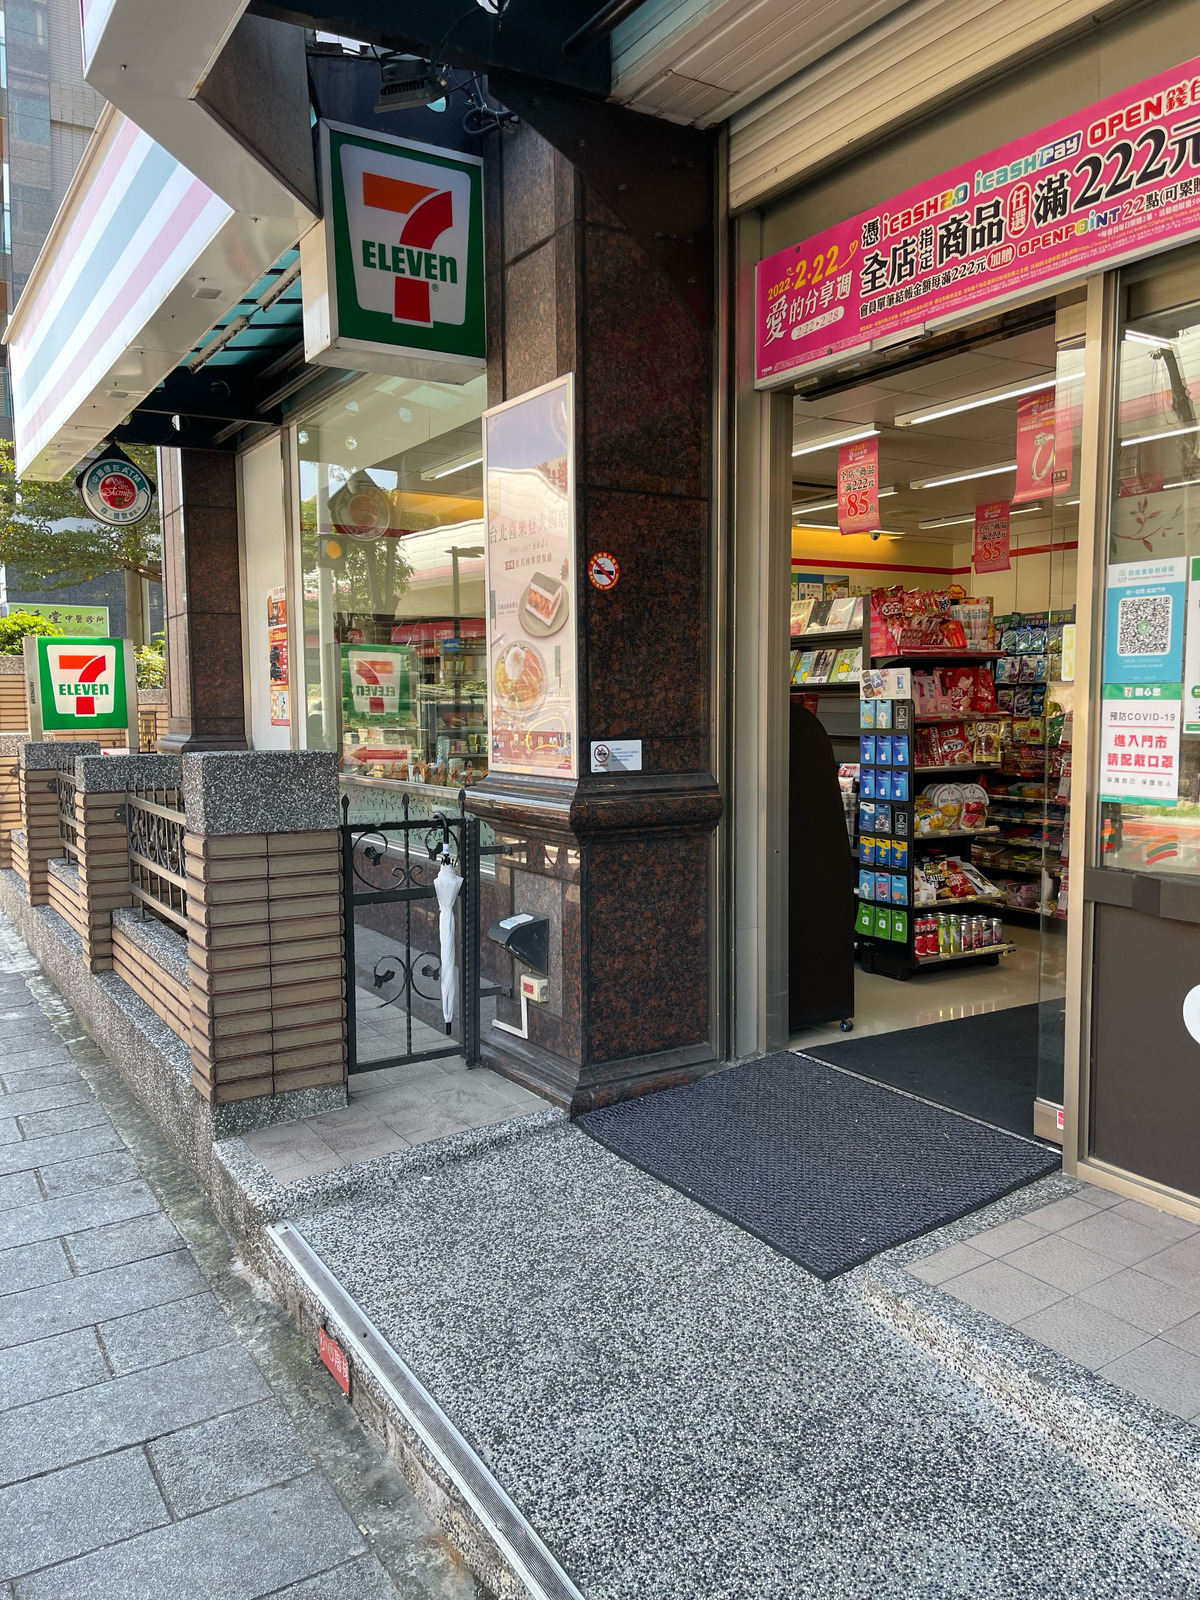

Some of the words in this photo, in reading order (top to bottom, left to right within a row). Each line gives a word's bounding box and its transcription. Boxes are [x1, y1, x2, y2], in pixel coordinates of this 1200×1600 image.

[362, 171, 453, 323] 7
[861, 237, 916, 296] 全店
[919, 227, 933, 272] 指定
[938, 199, 1004, 266] 商品
[1011, 189, 1027, 233] 任選
[863, 219, 879, 247] 憑
[990, 247, 1013, 268] 加贈
[764, 271, 852, 347] 愛的分享週
[847, 489, 869, 518] 85
[982, 540, 1002, 561] 85
[58, 655, 106, 714] 7
[1110, 711, 1176, 722] 預防COVID-19
[1114, 734, 1168, 749] 進入門市
[1107, 752, 1174, 769] 請配戴口罩
